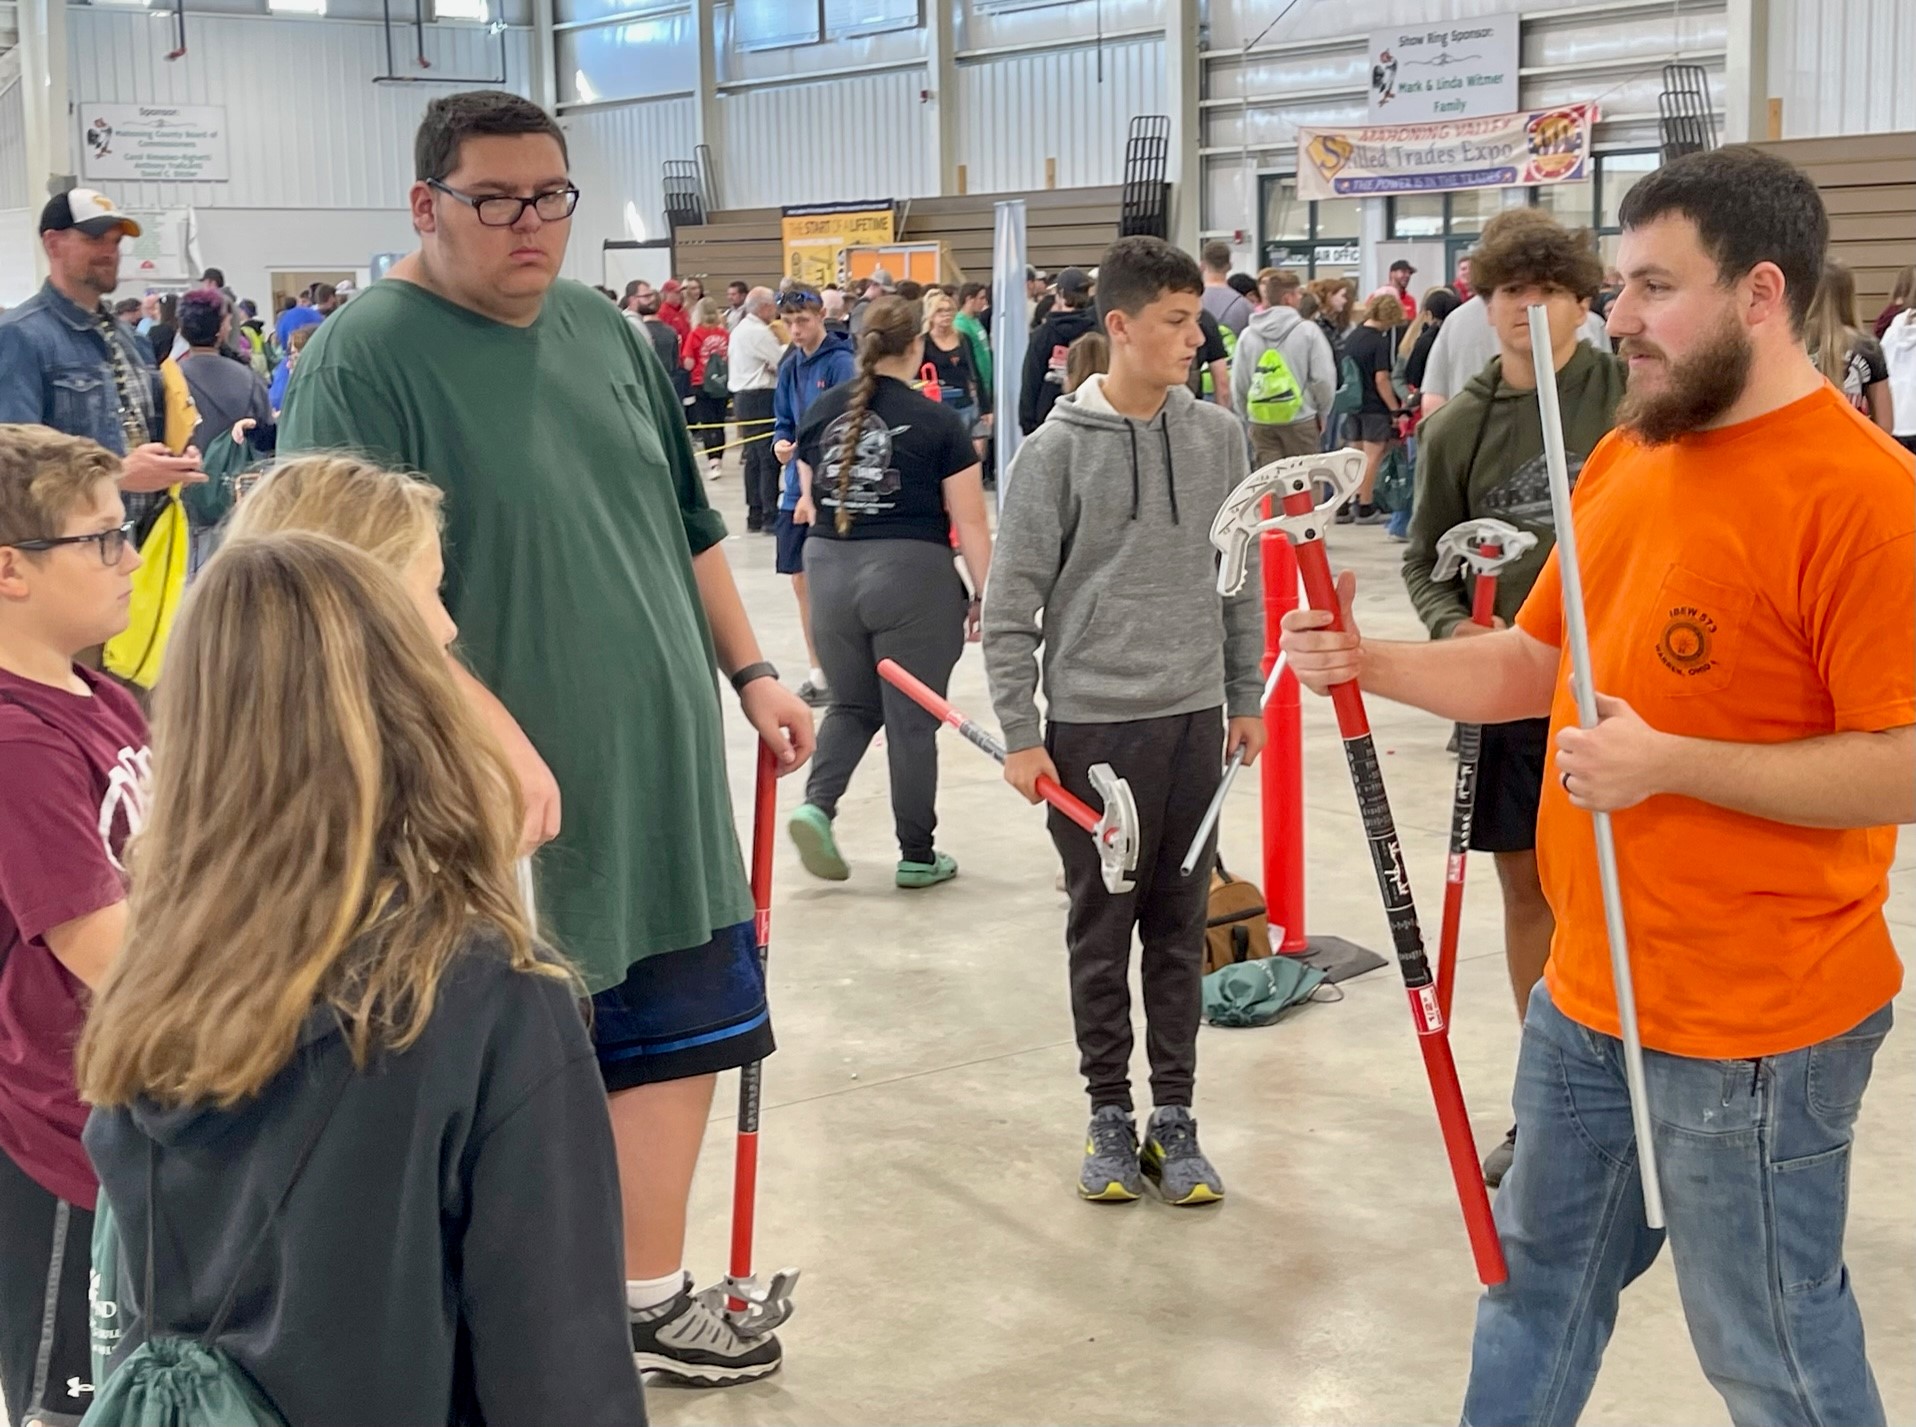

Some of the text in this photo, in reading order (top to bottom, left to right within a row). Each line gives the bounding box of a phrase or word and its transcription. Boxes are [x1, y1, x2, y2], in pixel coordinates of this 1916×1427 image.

[1398, 27, 1494, 48] Show Ring Sponsor:
[1398, 81, 1422, 93] Mark
[1436, 75, 1463, 90] Linda
[1466, 73, 1504, 87] Witmer
[1433, 98, 1467, 114] Family
[1358, 124, 1450, 142] MAHONING
[1392, 141, 1456, 168] Trades
[1462, 140, 1513, 169] Expo
[1669, 607, 1717, 633] IBEW 573
